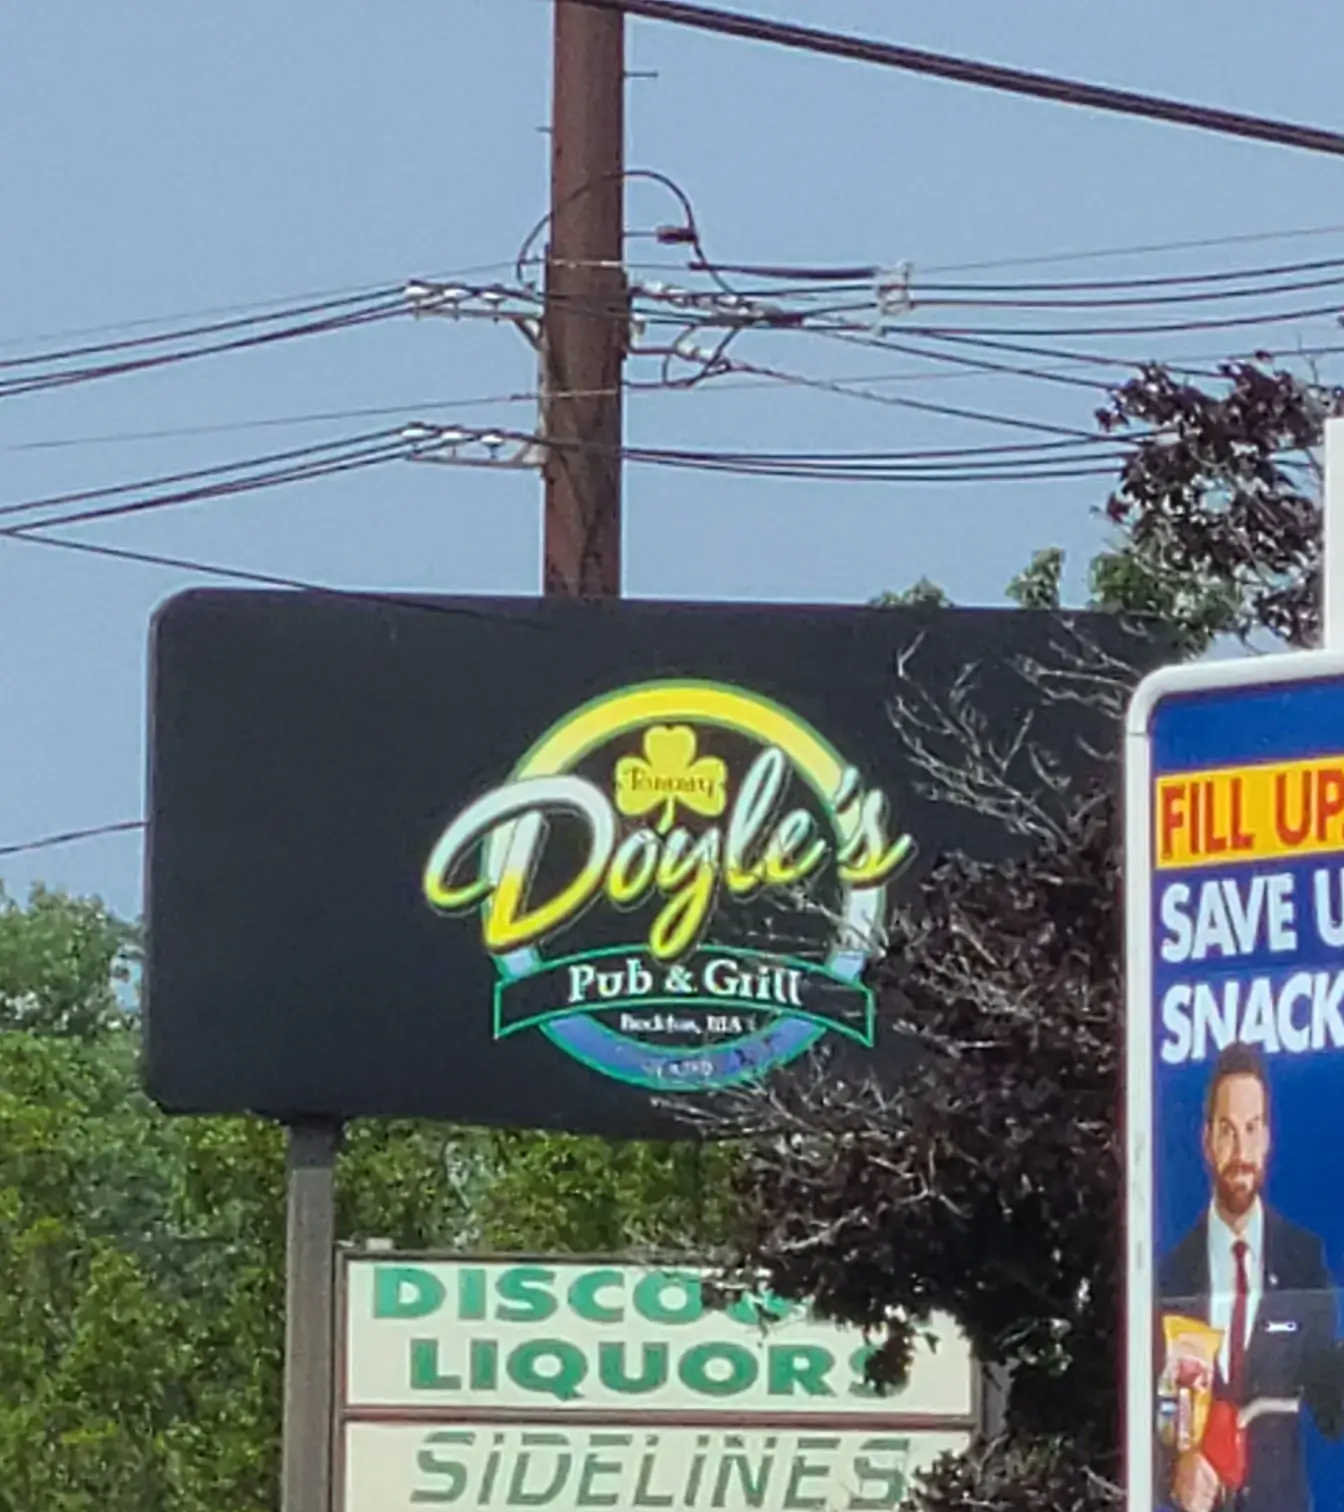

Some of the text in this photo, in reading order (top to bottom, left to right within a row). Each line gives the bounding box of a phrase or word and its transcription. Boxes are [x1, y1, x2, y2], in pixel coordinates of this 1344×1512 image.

[424, 746, 914, 960] Doyle's
[1160, 777, 1255, 860] FILL
[1160, 872, 1298, 963] SAVE
[568, 958, 803, 1006] Pub & Grill
[373, 1265, 930, 1325] DISCO
[410, 1431, 912, 1512] SIDELINES
